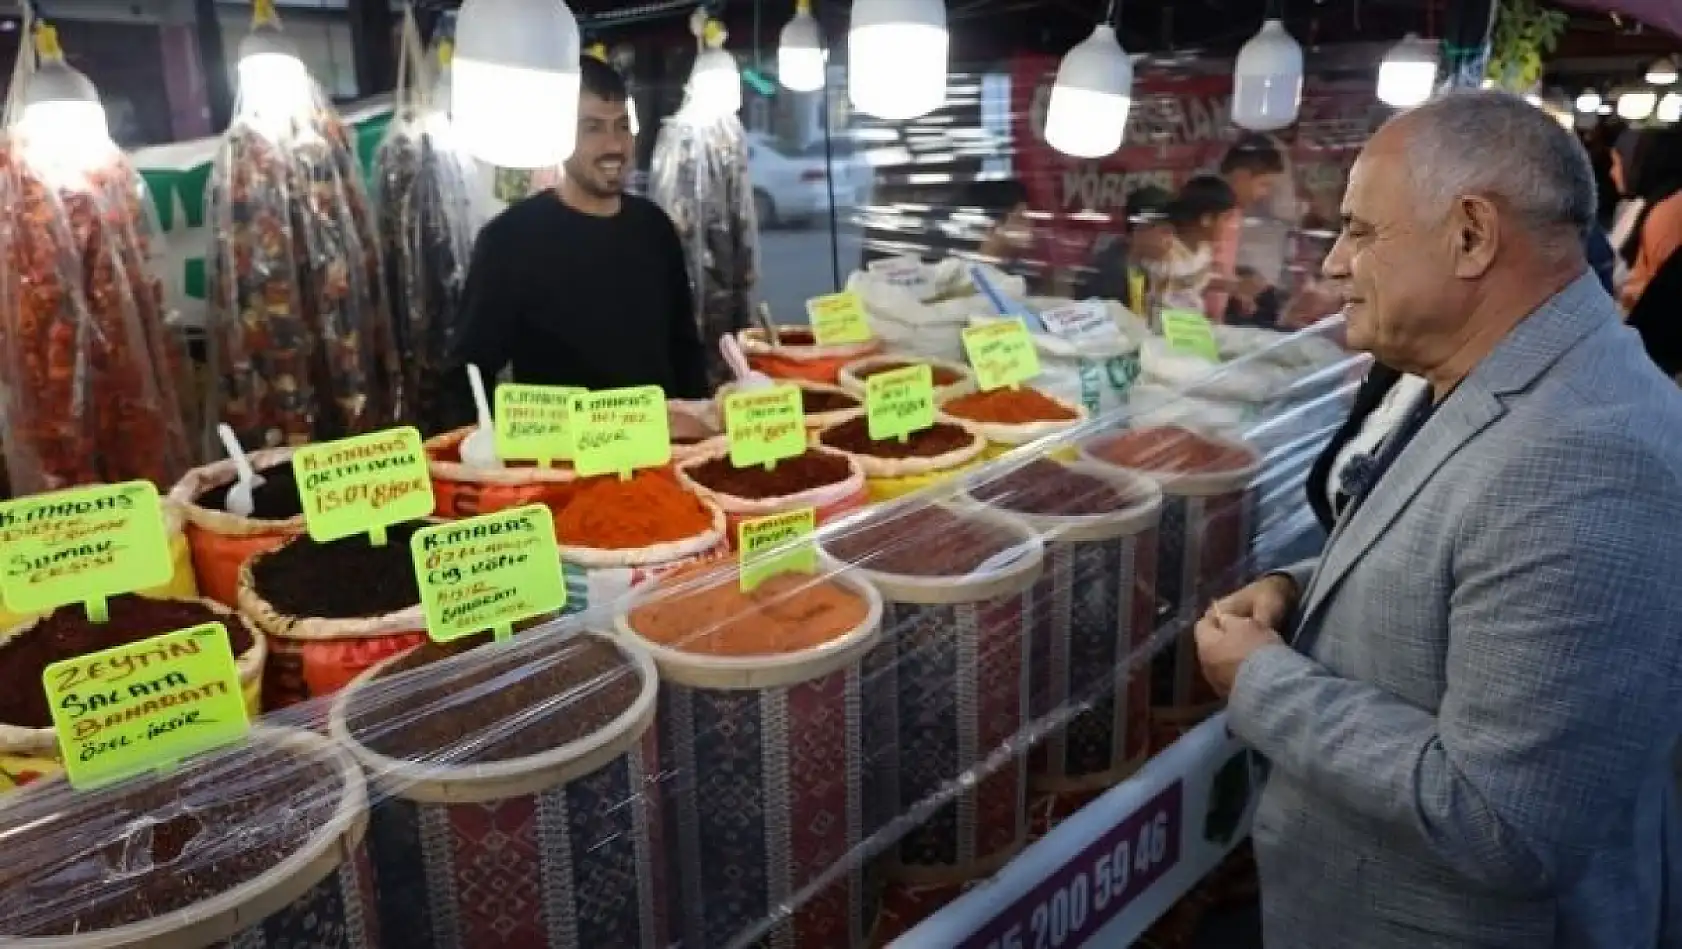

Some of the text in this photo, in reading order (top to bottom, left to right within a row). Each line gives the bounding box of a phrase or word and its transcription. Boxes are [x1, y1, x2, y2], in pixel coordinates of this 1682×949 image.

[1030, 872, 1088, 949] 200
[1094, 840, 1131, 911] 59
[1134, 811, 1169, 871] 46
